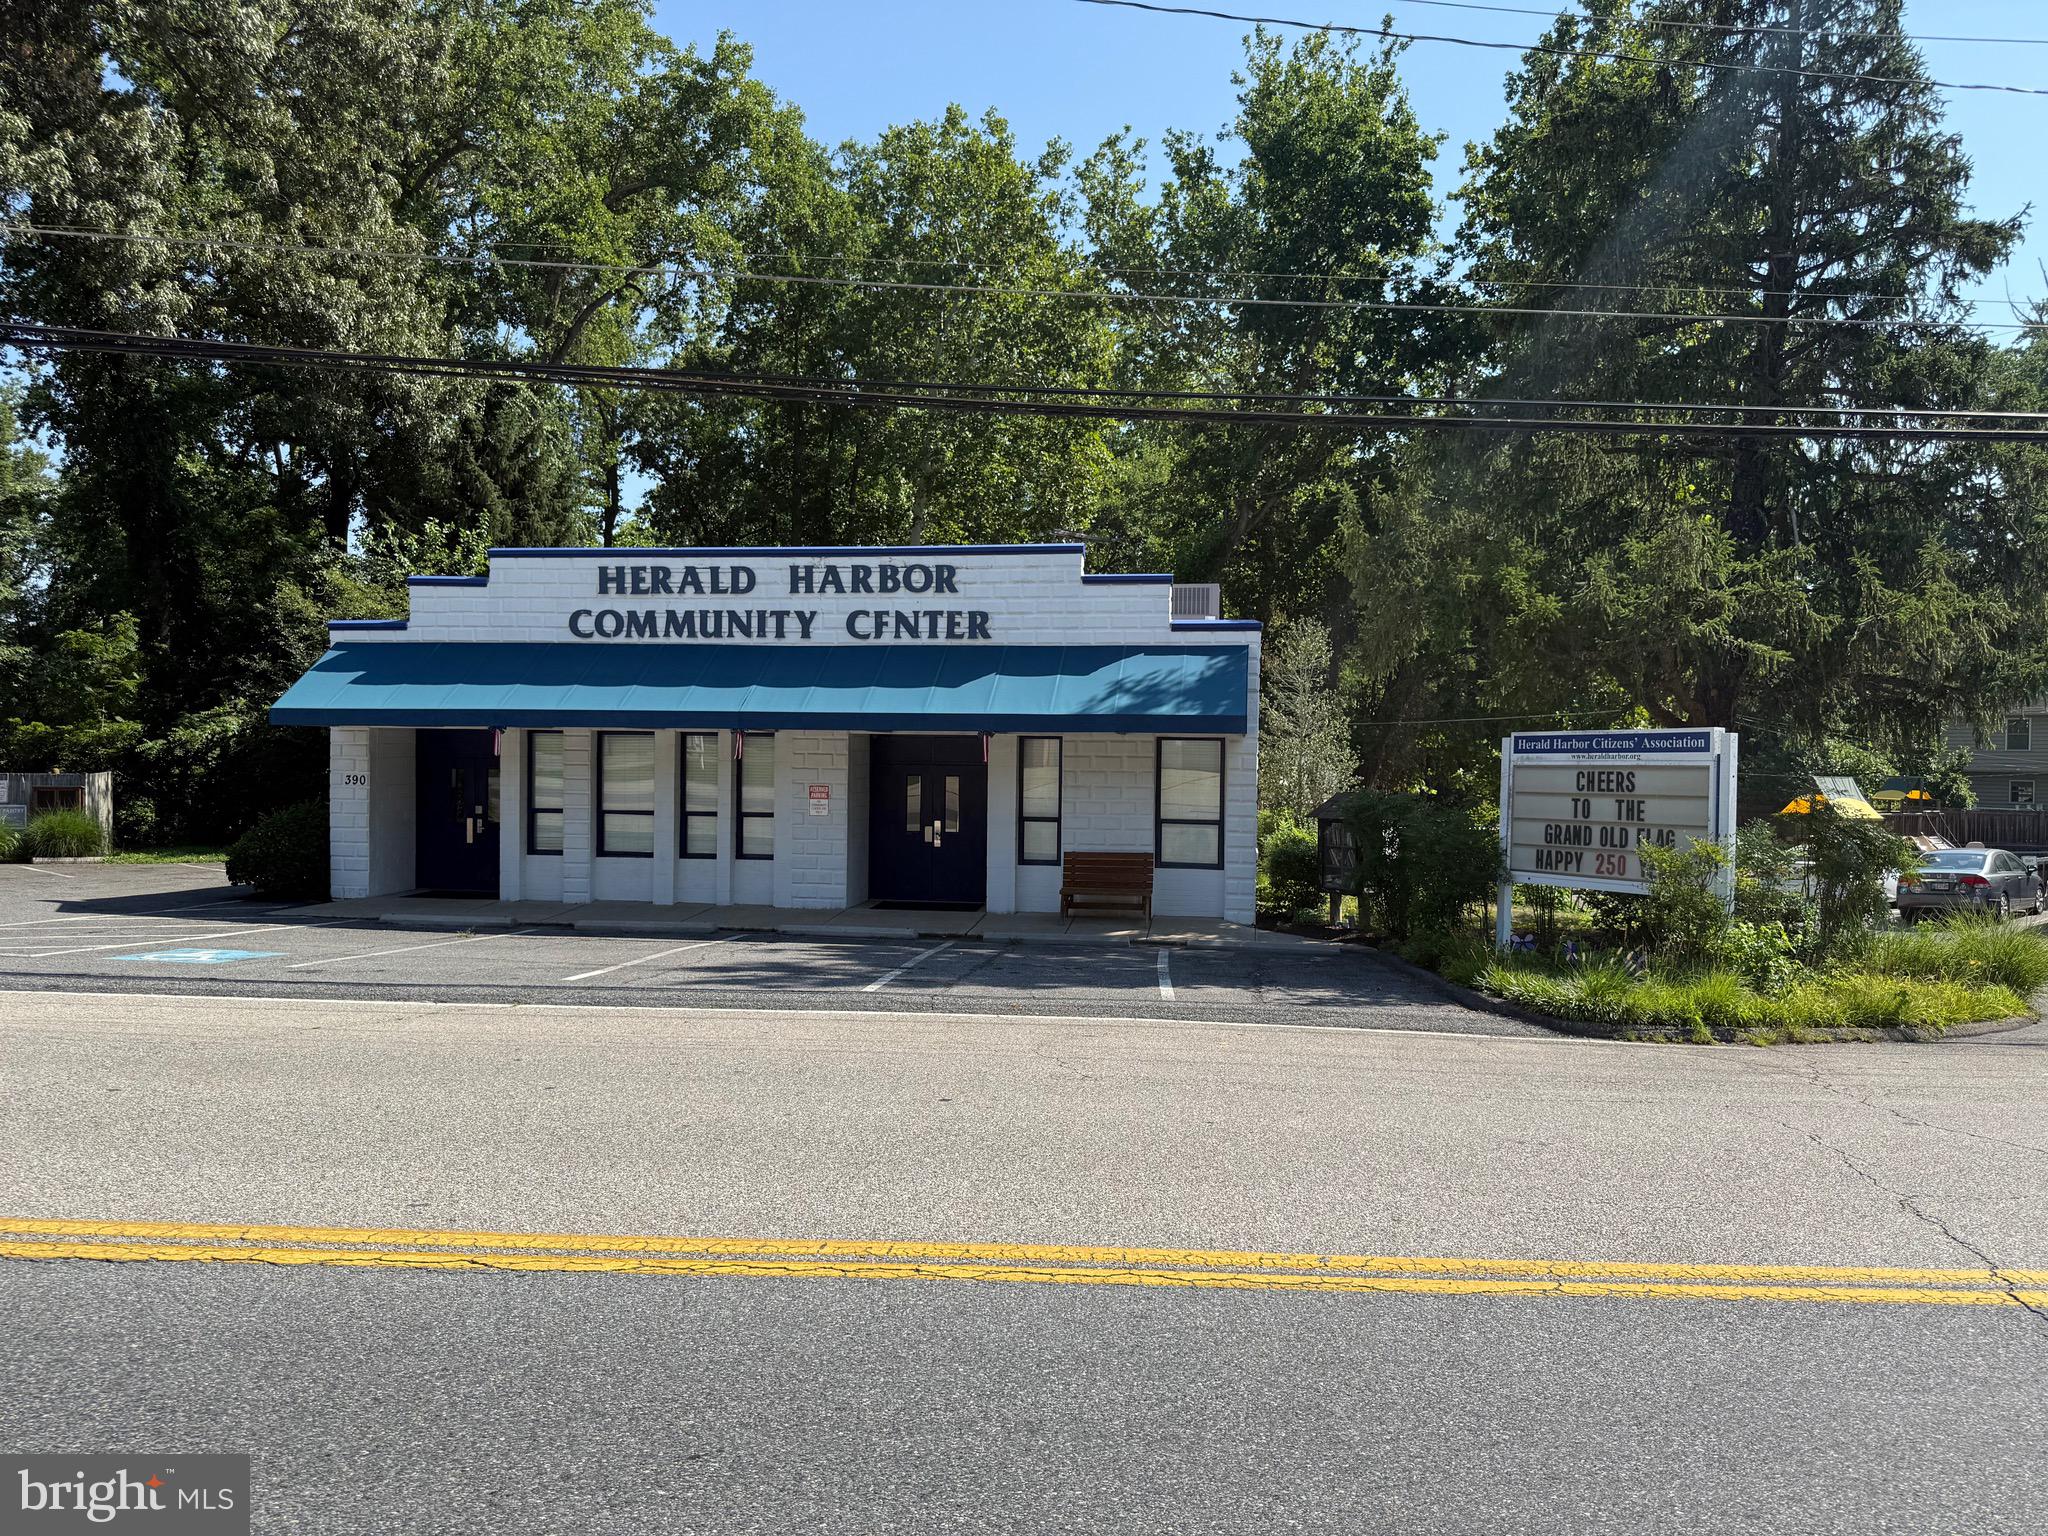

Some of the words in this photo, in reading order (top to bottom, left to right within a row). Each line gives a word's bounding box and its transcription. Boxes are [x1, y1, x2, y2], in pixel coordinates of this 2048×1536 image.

[598, 566, 756, 595] HERALD
[789, 564, 959, 595] HARBOR
[568, 609, 817, 639] COMMUNITY
[1518, 739, 1550, 750] Herald
[1553, 738, 1590, 750] Harbor
[1641, 736, 1705, 748] Association
[1571, 753, 1641, 761] www.heraldharbor.org
[345, 775, 366, 785] 390
[1576, 771, 1636, 793] CHEERS
[1571, 798, 1591, 819] TO
[1615, 799, 1645, 822] THE
[1544, 823, 1592, 847] GRAND
[1600, 826, 1629, 849] OLD
[1535, 848, 1584, 873] HAPPY
[1595, 852, 1627, 877] 250
